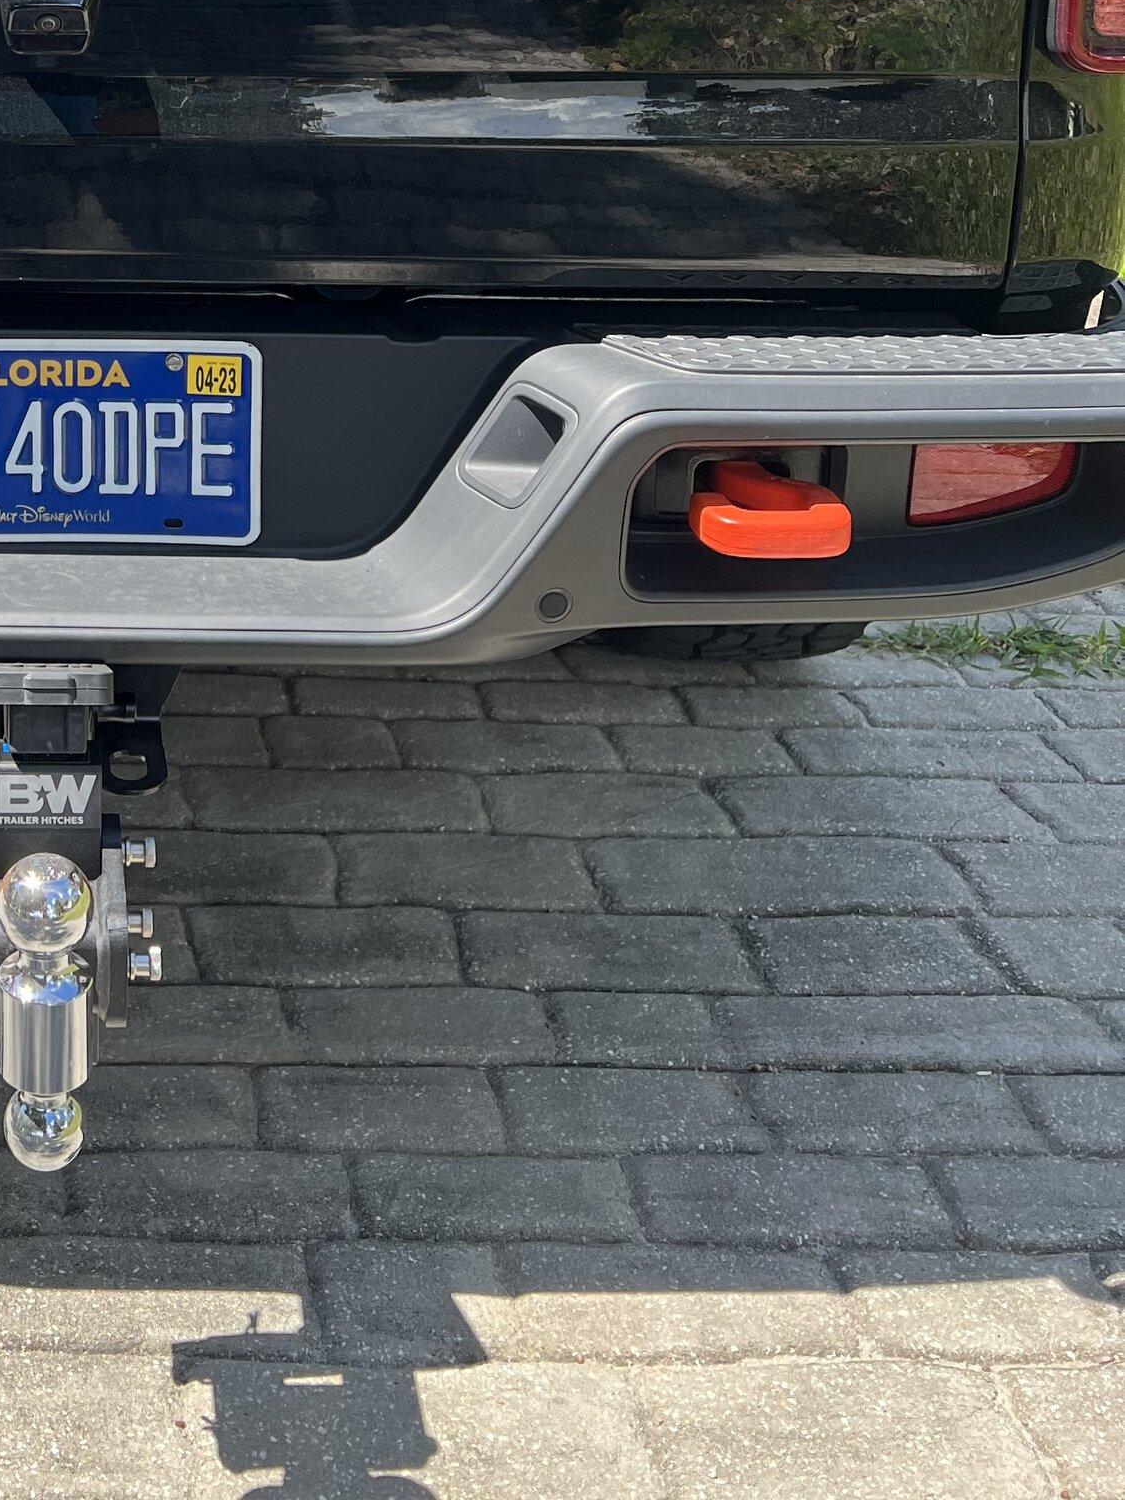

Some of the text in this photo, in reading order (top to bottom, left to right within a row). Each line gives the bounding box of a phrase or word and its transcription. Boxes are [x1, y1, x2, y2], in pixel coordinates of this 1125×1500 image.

[196, 365, 237, 394] 04-23
[74, 510, 111, 523] World
[41, 816, 84, 825] HITCHES
